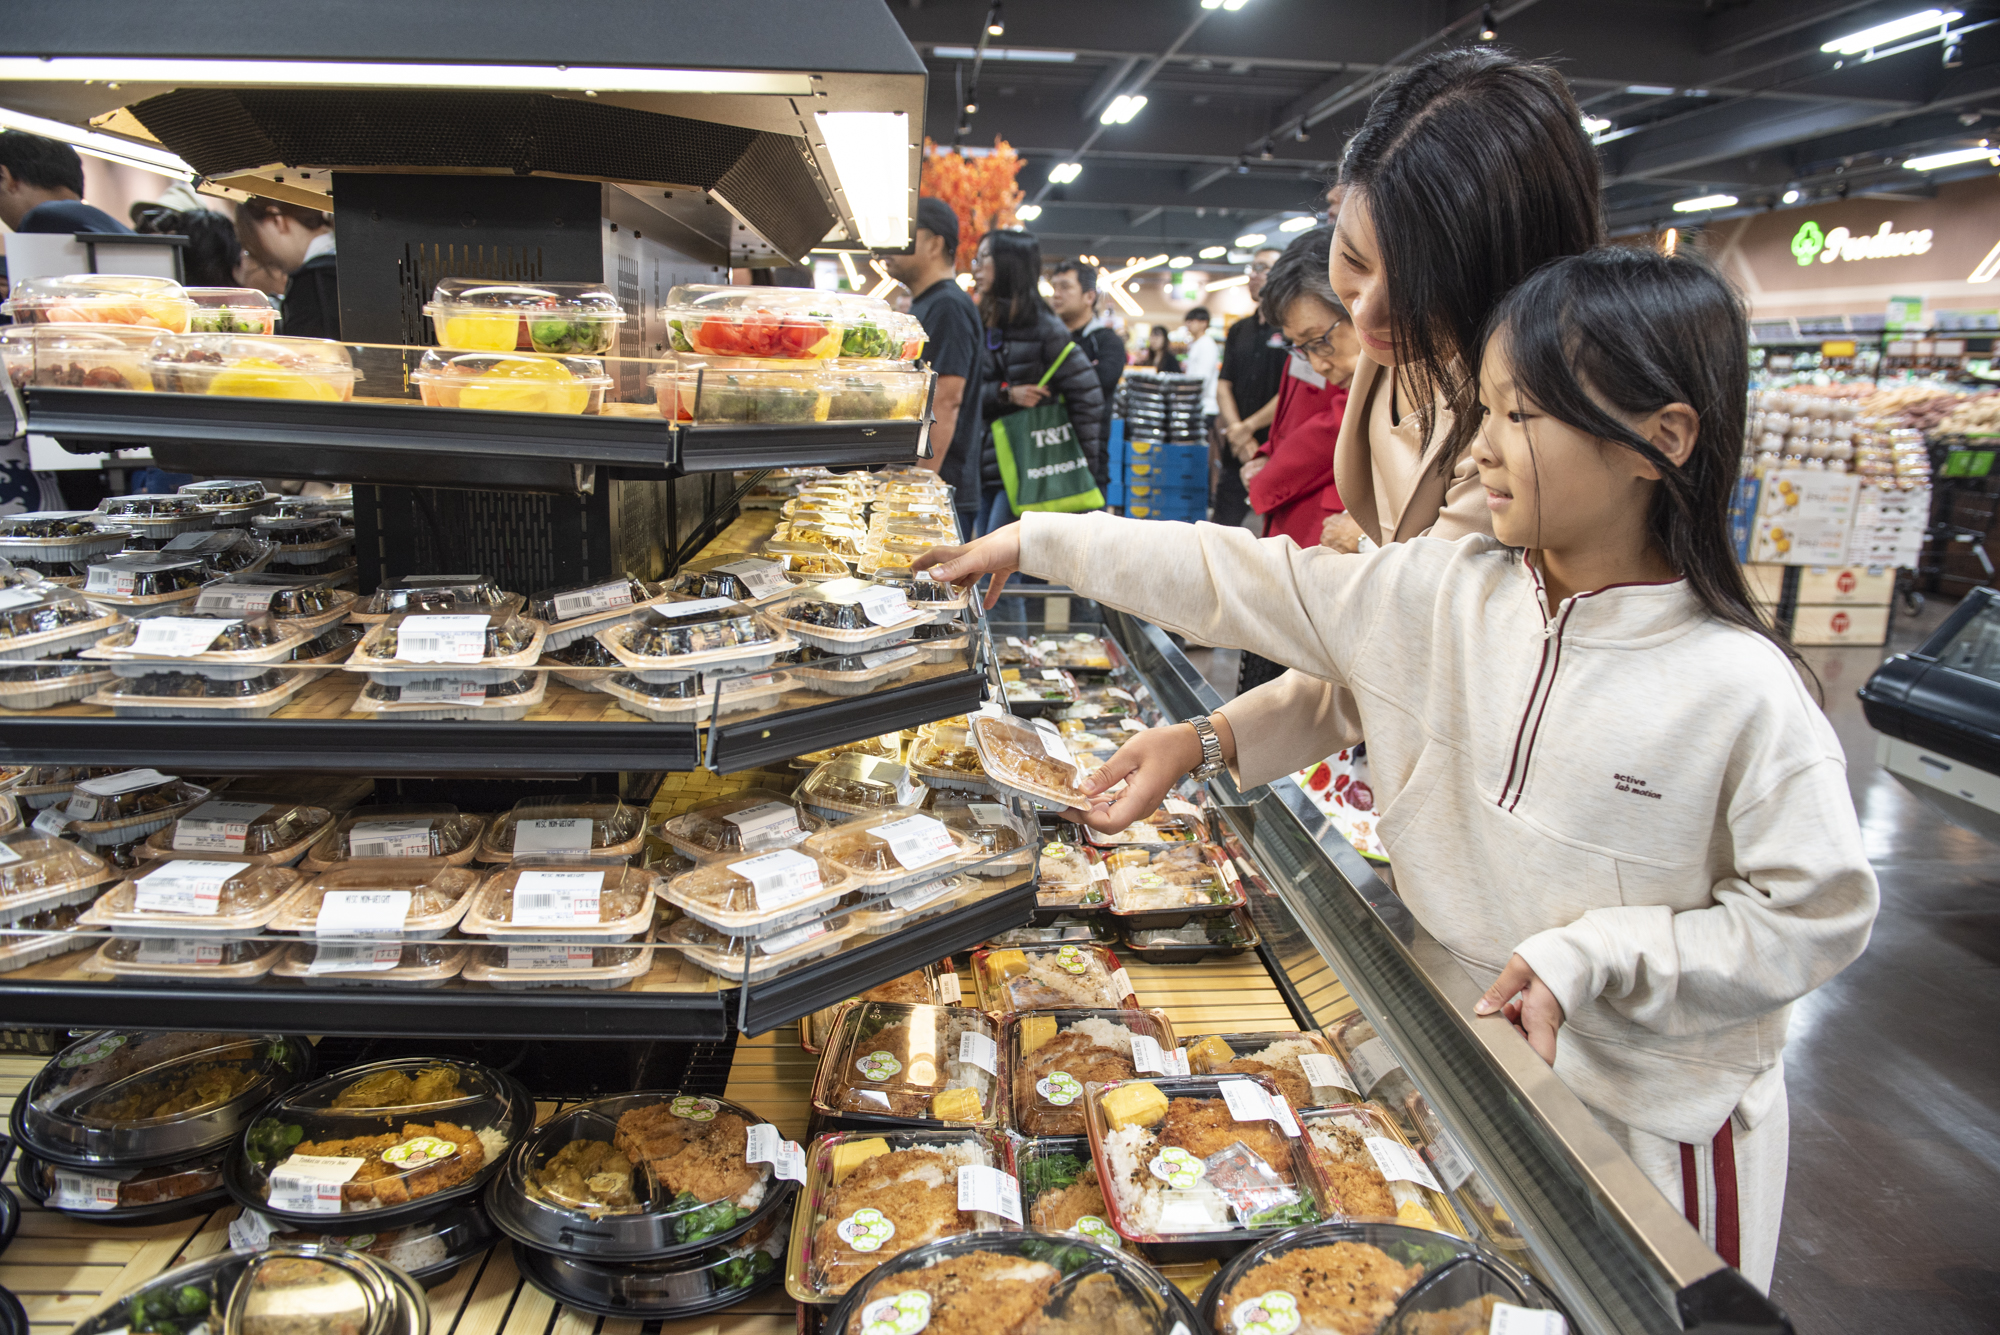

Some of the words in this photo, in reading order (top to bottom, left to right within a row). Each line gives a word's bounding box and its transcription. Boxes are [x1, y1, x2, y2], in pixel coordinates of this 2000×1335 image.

[1820, 221, 1932, 263] Produce
[1031, 422, 1072, 447] T&T
[1613, 773, 1646, 786] active
[1615, 781, 1630, 792] lab
[1631, 788, 1662, 800] motion
[535, 820, 547, 828] MISC
[549, 820, 576, 828] NON-WEIGHT
[416, 845, 428, 853] 4.99
[345, 895, 357, 903] MISC
[361, 894, 391, 904] NON-WEIGHT
[299, 1157, 320, 1165] Tonkatsu
[853, 1212, 888, 1248] お弁当
